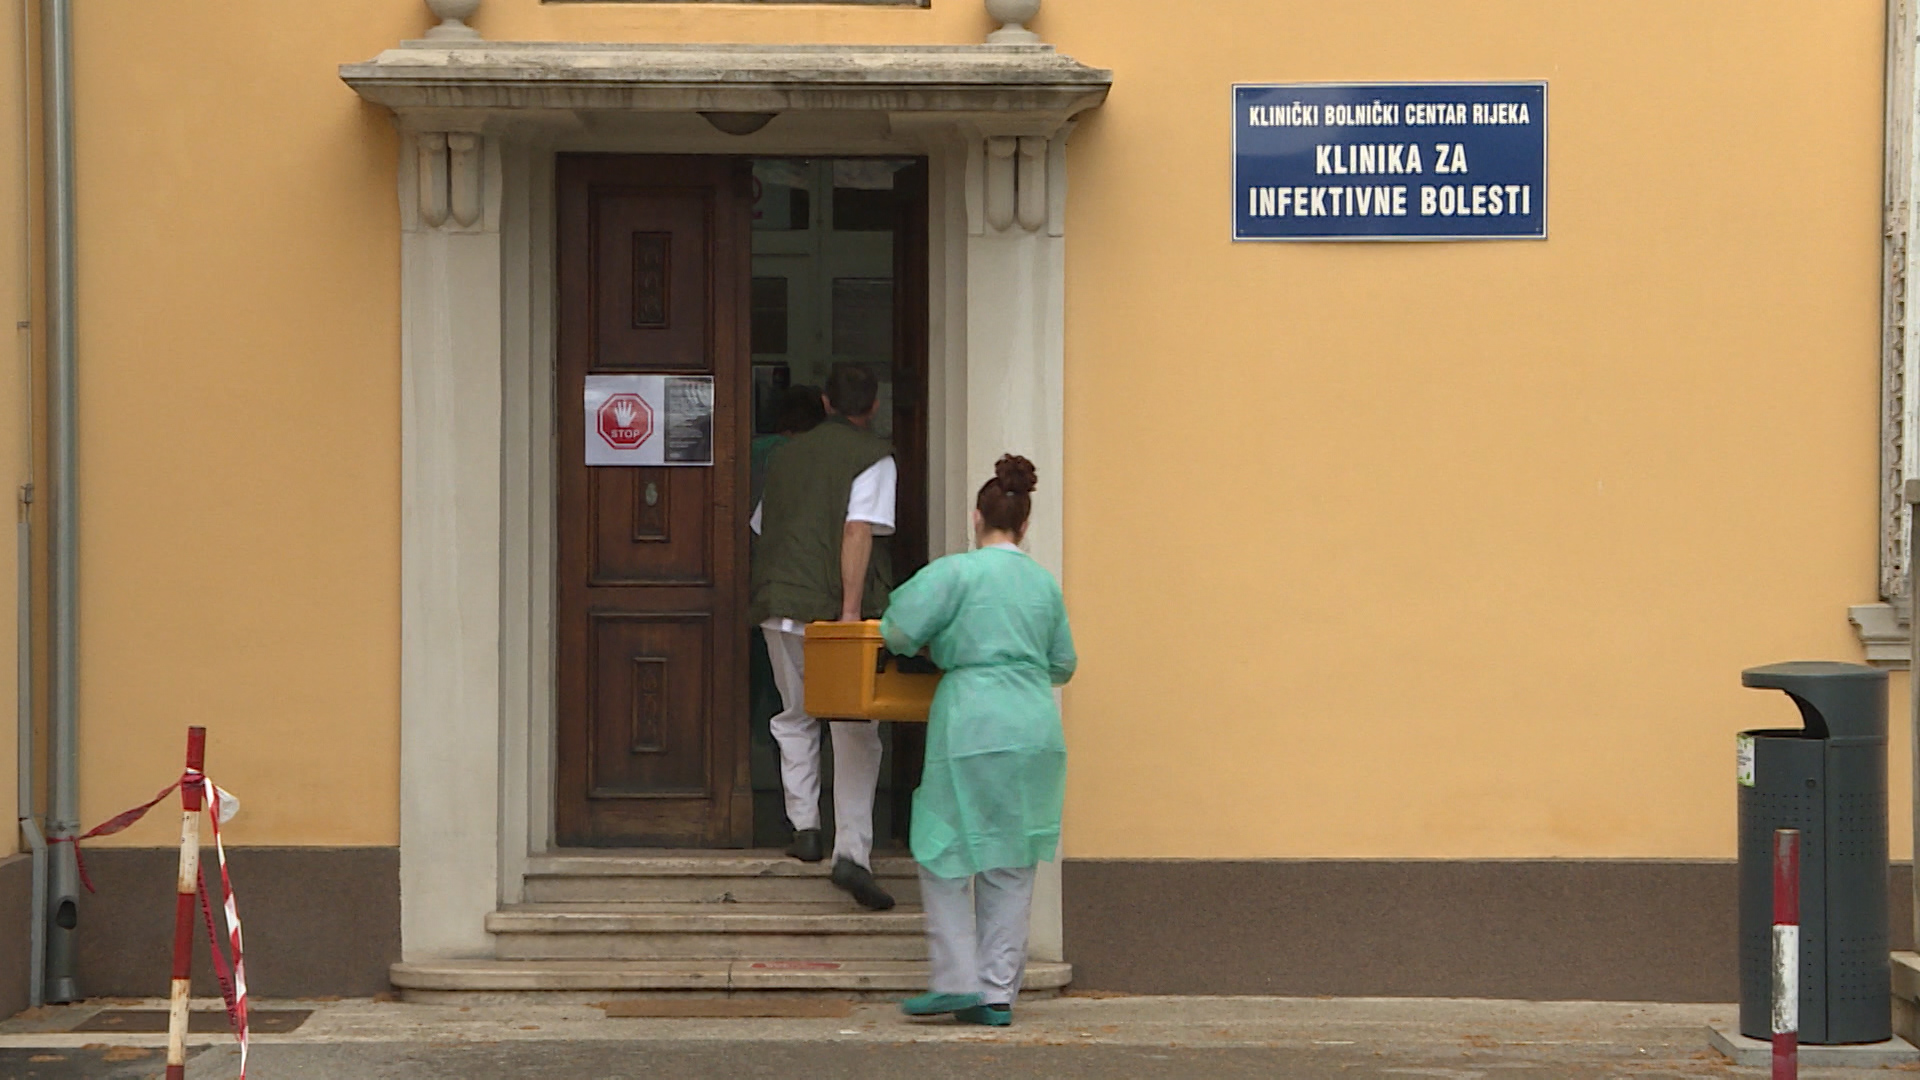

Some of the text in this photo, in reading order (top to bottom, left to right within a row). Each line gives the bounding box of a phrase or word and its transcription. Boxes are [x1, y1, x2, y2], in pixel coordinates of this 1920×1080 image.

[1249, 100, 1530, 126] KLINIČKI BOLNIČKI CENTAR RIJEKA
[1315, 143, 1468, 175] KLINIKA ZA
[1249, 184, 1531, 216] INFEKTIVNE BOLESTI
[610, 429, 640, 438] STOP
